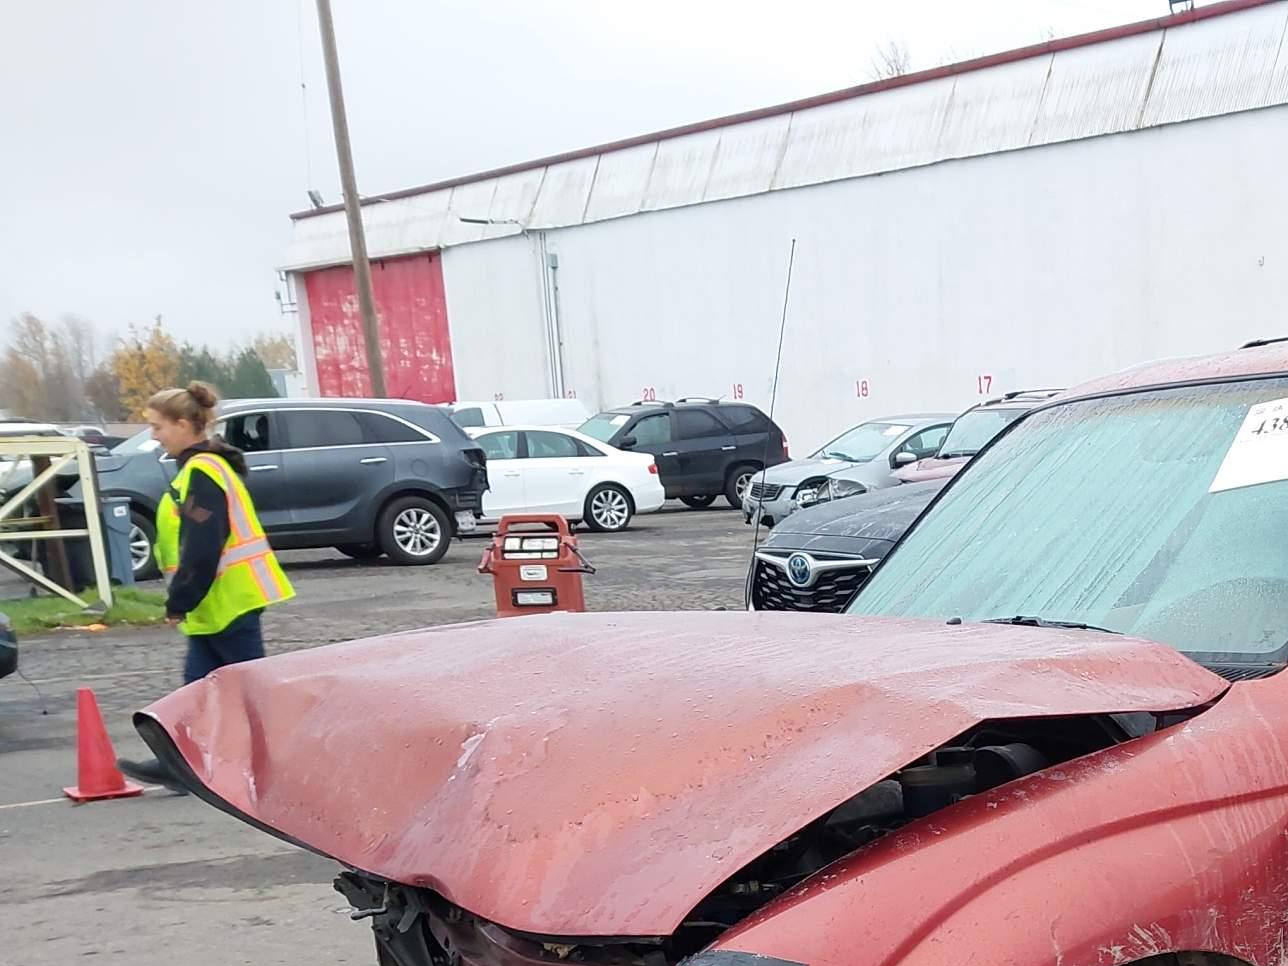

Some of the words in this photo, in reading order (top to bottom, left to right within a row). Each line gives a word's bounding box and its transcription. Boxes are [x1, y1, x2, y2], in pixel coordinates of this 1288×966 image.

[733, 383, 744, 399] 19
[856, 380, 869, 397] 18
[978, 375, 992, 394] 17
[643, 387, 656, 401] 20
